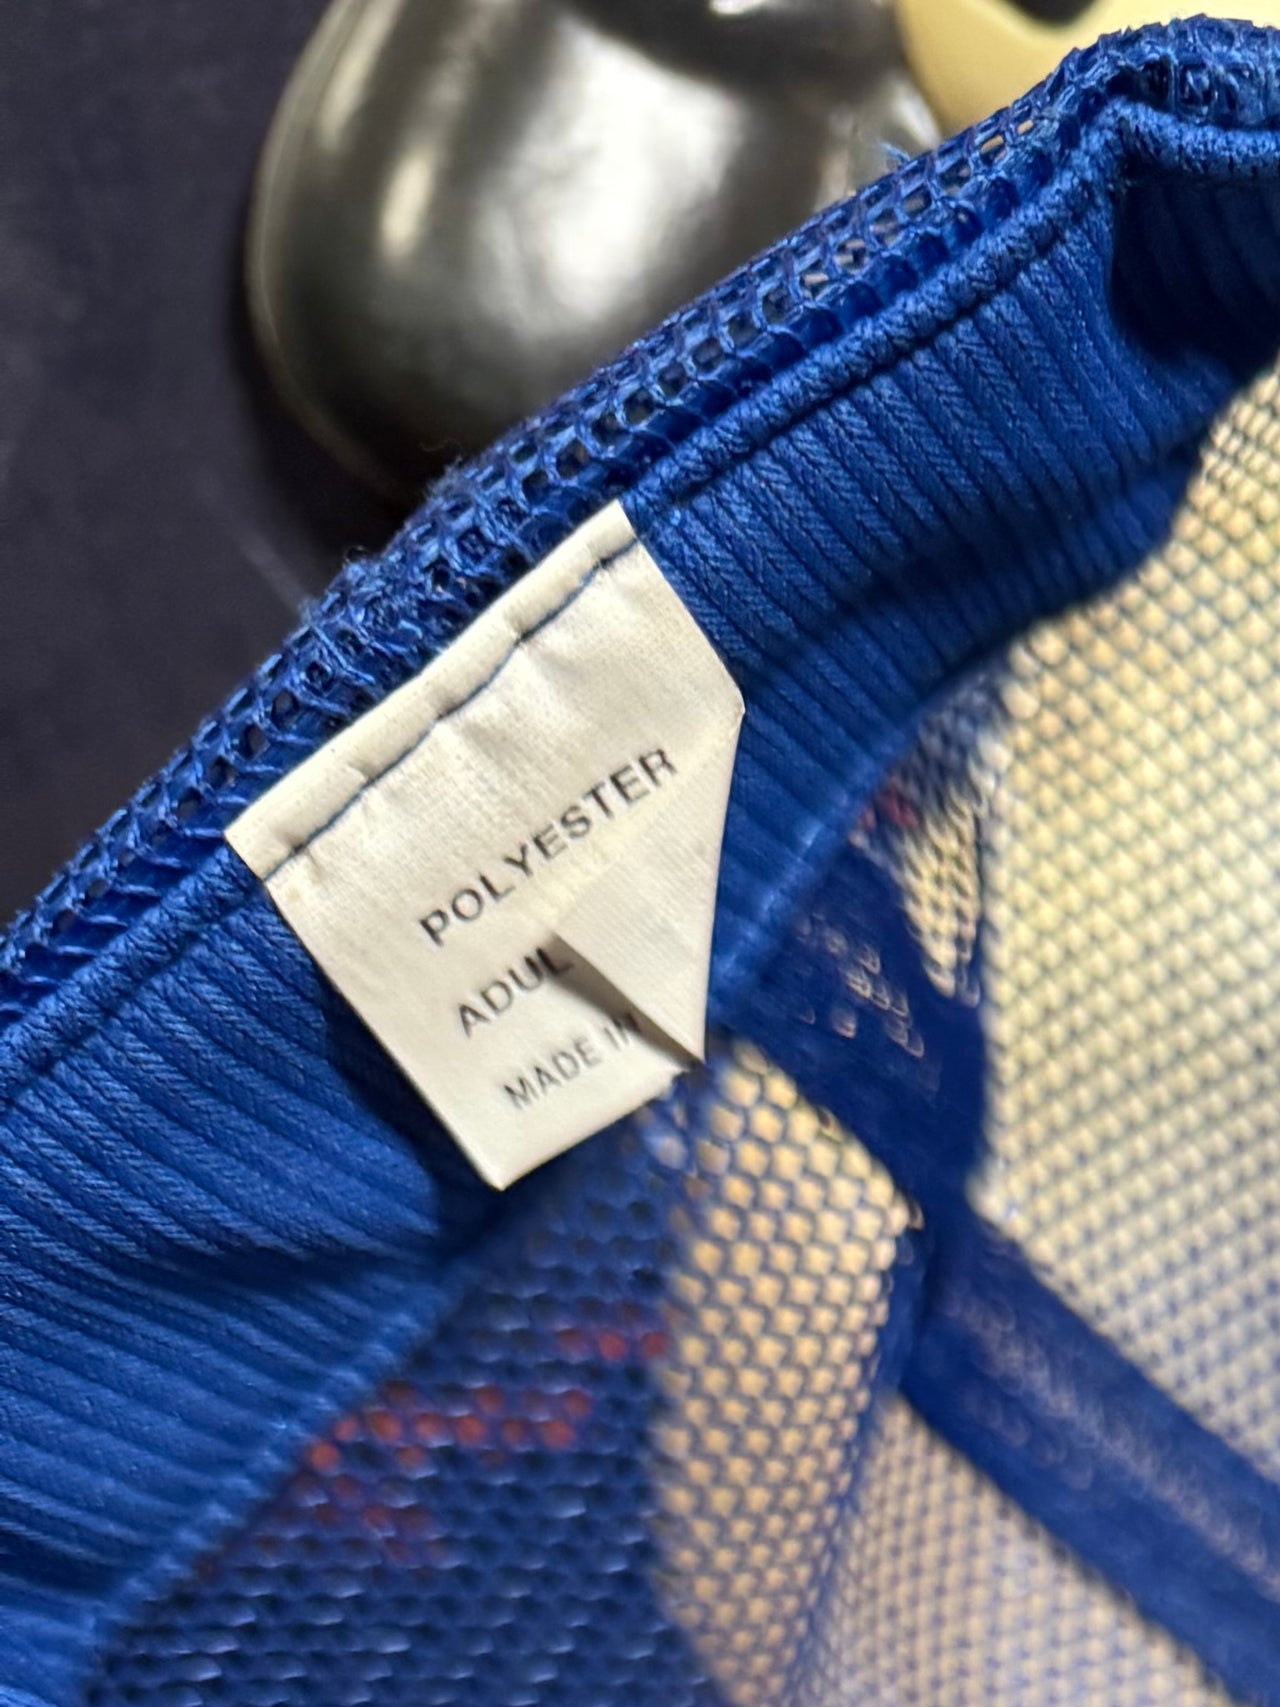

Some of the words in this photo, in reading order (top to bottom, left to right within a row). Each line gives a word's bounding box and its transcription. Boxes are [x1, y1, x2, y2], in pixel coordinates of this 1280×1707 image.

[418, 747, 678, 948] POLYESTER
[457, 946, 575, 1039] ADUL
[503, 1036, 604, 1110] MADE
